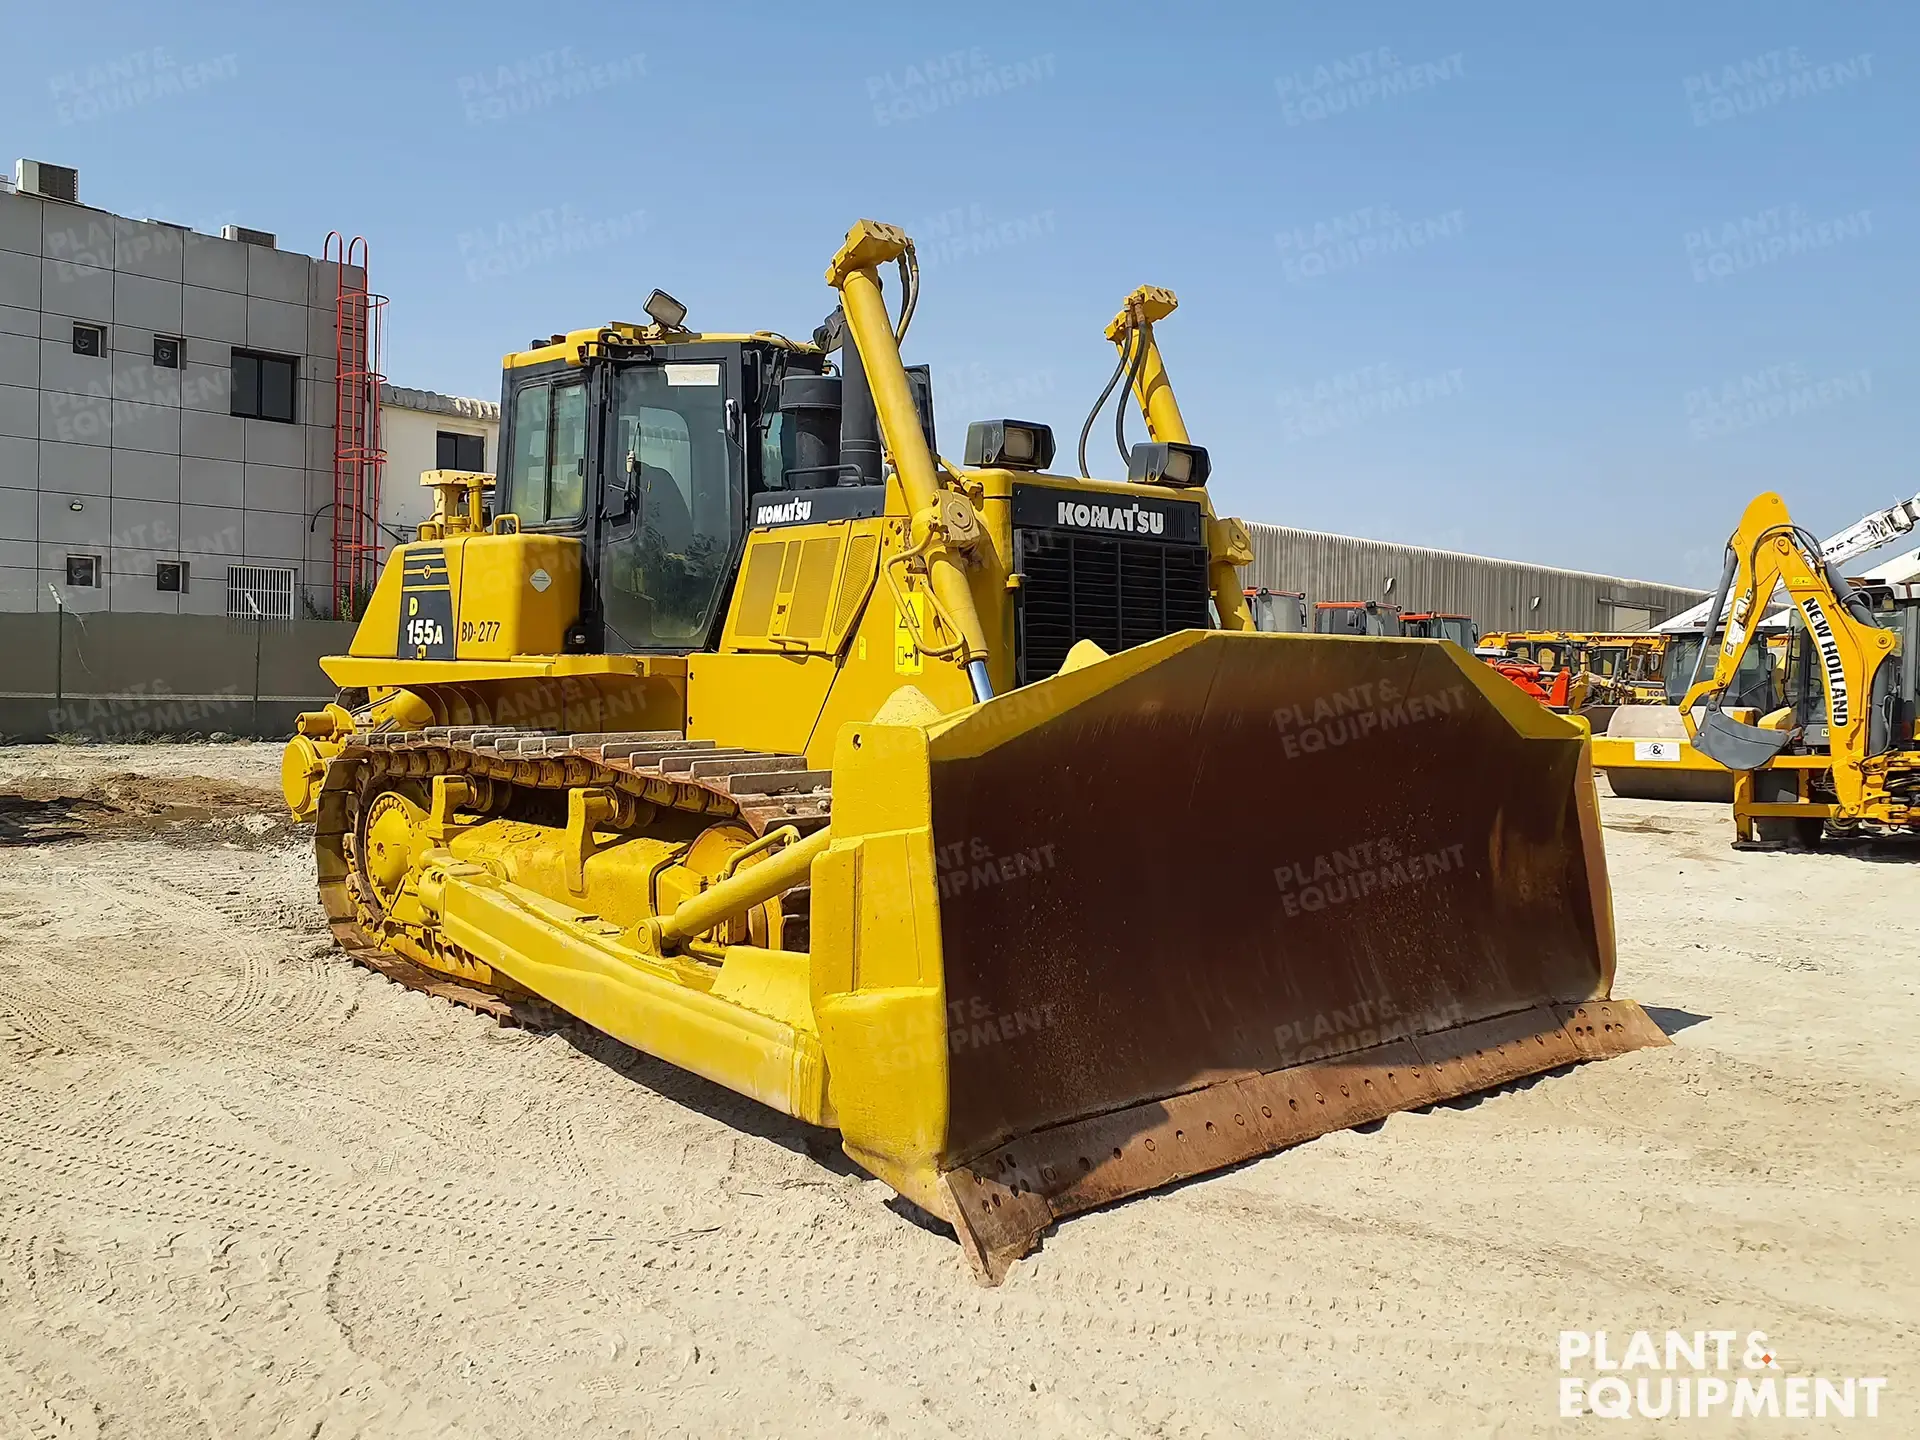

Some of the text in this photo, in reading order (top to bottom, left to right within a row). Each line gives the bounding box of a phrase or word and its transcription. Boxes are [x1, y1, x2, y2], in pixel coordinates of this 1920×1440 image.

[757, 497, 812, 524] KOMATSU
[1057, 502, 1164, 535] KOMATSU
[408, 597, 419, 616] D
[407, 619, 444, 645] 155A
[1802, 597, 1848, 727] NEW HOLLAND
